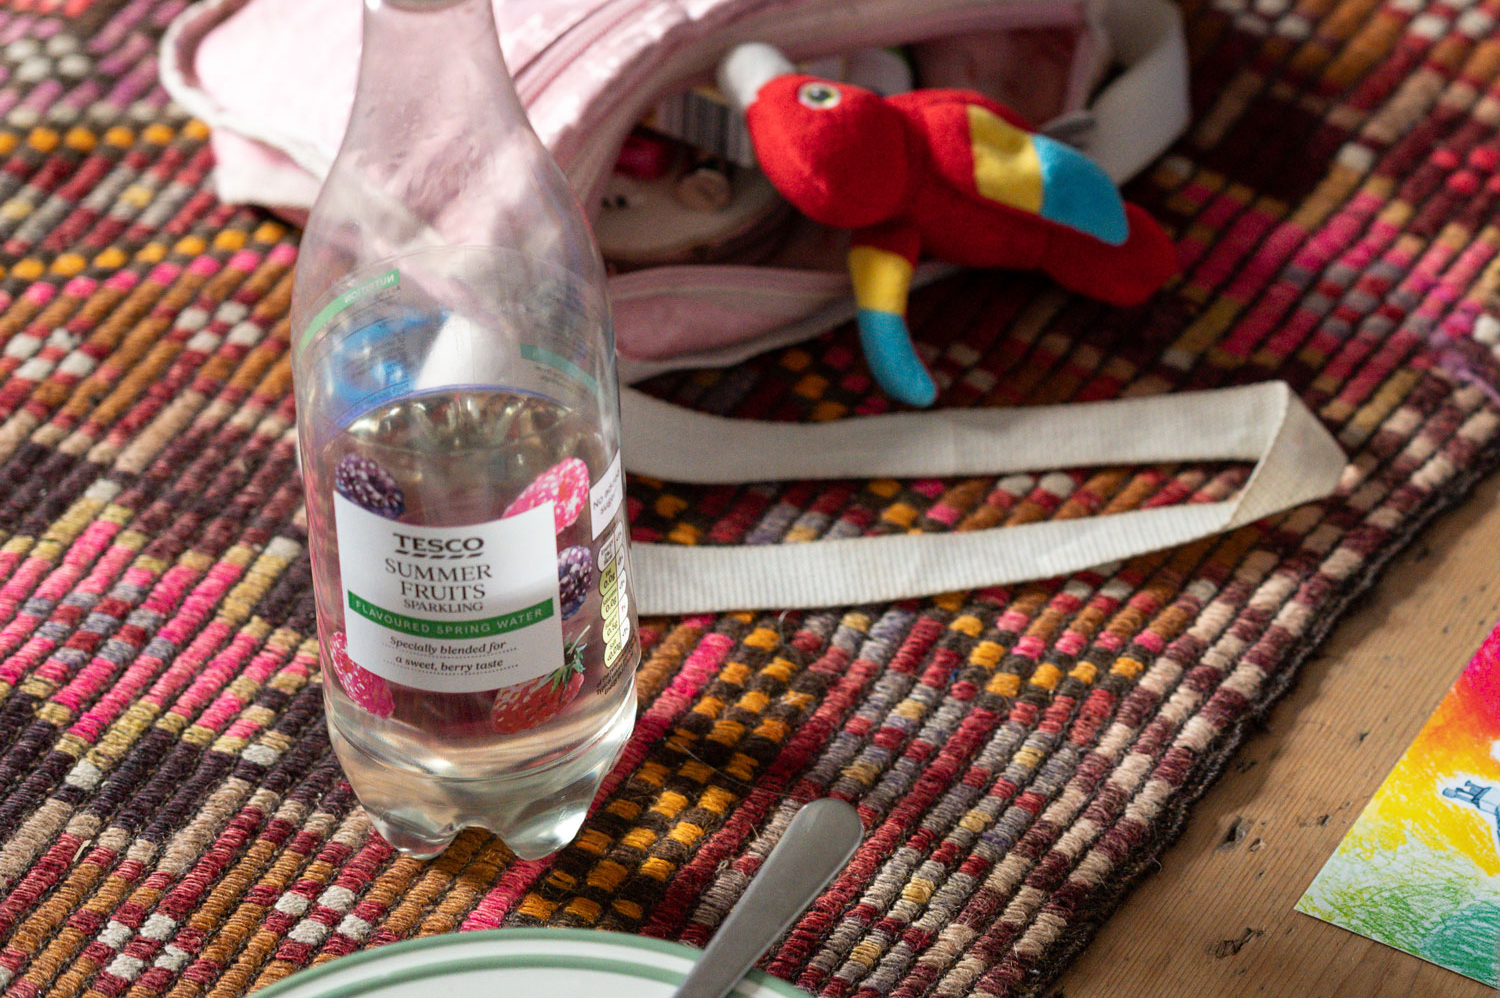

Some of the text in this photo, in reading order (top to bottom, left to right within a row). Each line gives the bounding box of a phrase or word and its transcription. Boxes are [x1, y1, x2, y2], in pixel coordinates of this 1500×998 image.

[392, 532, 485, 553] TESCO
[385, 557, 493, 582] SUMMER
[400, 580, 486, 601] FRUITS
[403, 598, 484, 614] SPARKLING
[355, 599, 543, 635] FLAVOURED SPRING WATER
[389, 635, 508, 655] Specially blended for
[395, 655, 504, 673] a sweet, berry taste
